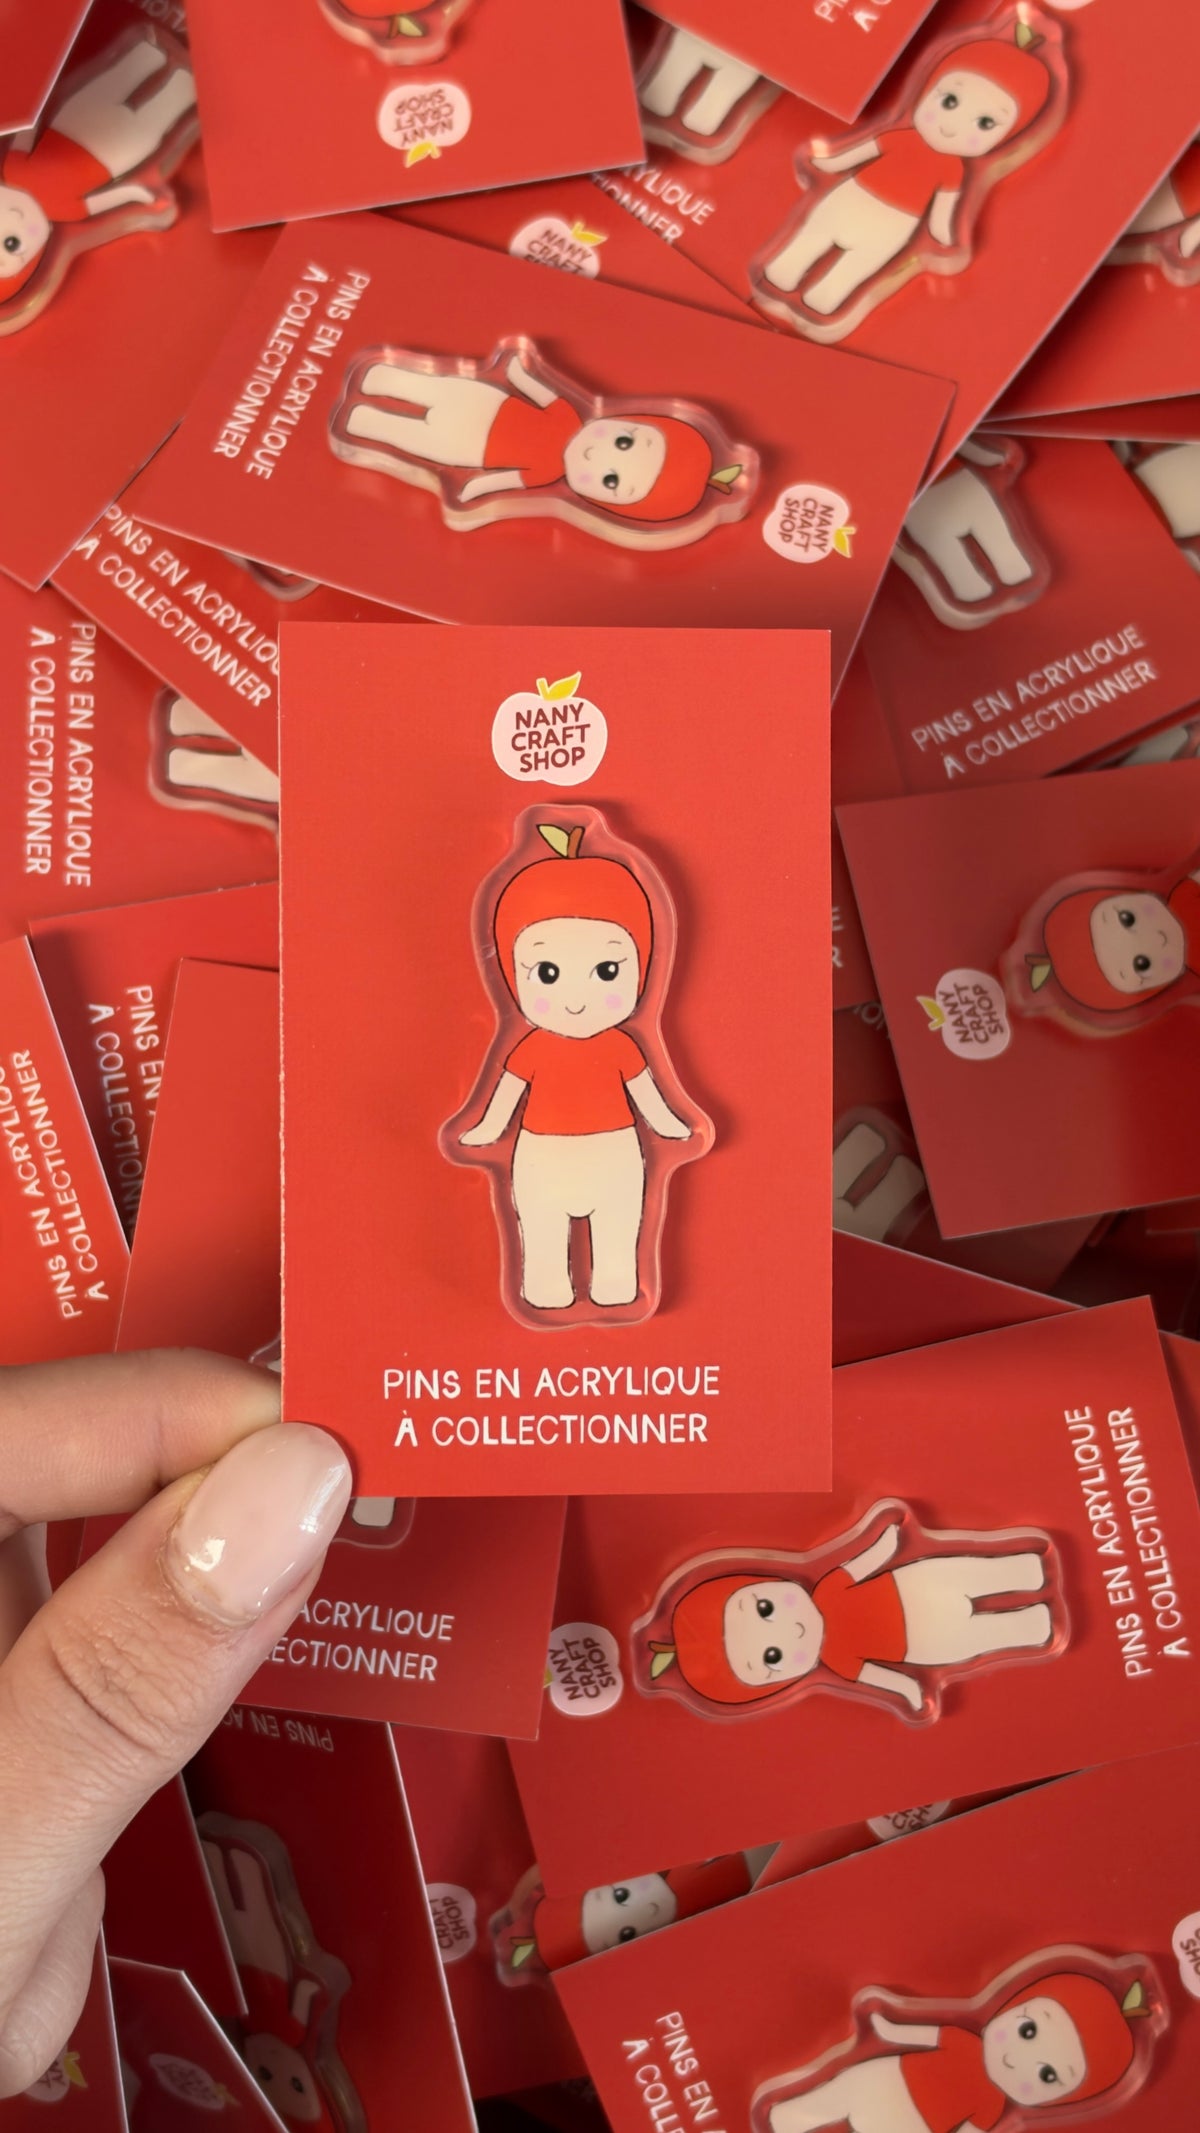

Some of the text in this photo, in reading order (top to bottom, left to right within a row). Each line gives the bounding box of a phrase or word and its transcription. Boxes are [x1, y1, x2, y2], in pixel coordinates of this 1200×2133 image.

[394, 103, 454, 132] CRAFT
[395, 88, 446, 115] SHOP
[402, 118, 453, 147] NANY
[542, 230, 592, 262] NANY
[213, 288, 320, 459] COLLECTIONNER
[246, 271, 371, 480] PINS EN ACRYLIQUE
[778, 498, 800, 543] SHOP
[794, 498, 818, 553] CRAFT
[812, 504, 835, 553] NANY
[149, 550, 190, 587] EN
[99, 555, 272, 707] COLLECTIONNER
[911, 624, 1146, 752] PINS EN ACRYLIQUE
[965, 660, 1158, 765] COLLECTIONNER
[511, 723, 591, 751] CRAFT
[515, 702, 584, 730] NANY
[25, 657, 56, 875] COLLECTIONNER
[65, 622, 97, 888] PINS EN ACRYLIQUE
[520, 746, 585, 773] SHOP
[88, 1003, 121, 1025] À
[126, 985, 160, 1051] PINS
[939, 990, 973, 1043] NANY
[953, 982, 989, 1044] CRAFT
[972, 984, 1005, 1034] SHOP
[12, 1049, 99, 1273] COLLECTIONNER
[31, 1207, 60, 1247] EN
[49, 1253, 83, 1320] PINS
[384, 1366, 720, 1400] PINS EN ACRYLIQUE
[394, 1410, 708, 1447] À COLLECTIONNER
[1064, 1405, 1153, 1678] PINS EN ACRYLIQUE
[1107, 1406, 1191, 1657] À COLLECTIONNER
[265, 1637, 438, 1681] ECTIONNER
[548, 1648, 583, 1701] NANY
[562, 1639, 601, 1699] CRAFT
[582, 1637, 616, 1689] SHOP
[250, 1710, 281, 1738] EN
[285, 1718, 334, 1753] PINS
[441, 1895, 470, 1940] SHOP
[622, 2037, 686, 2133] À COLL
[655, 2011, 699, 2076] PINS
[683, 2080, 719, 2122] EN
